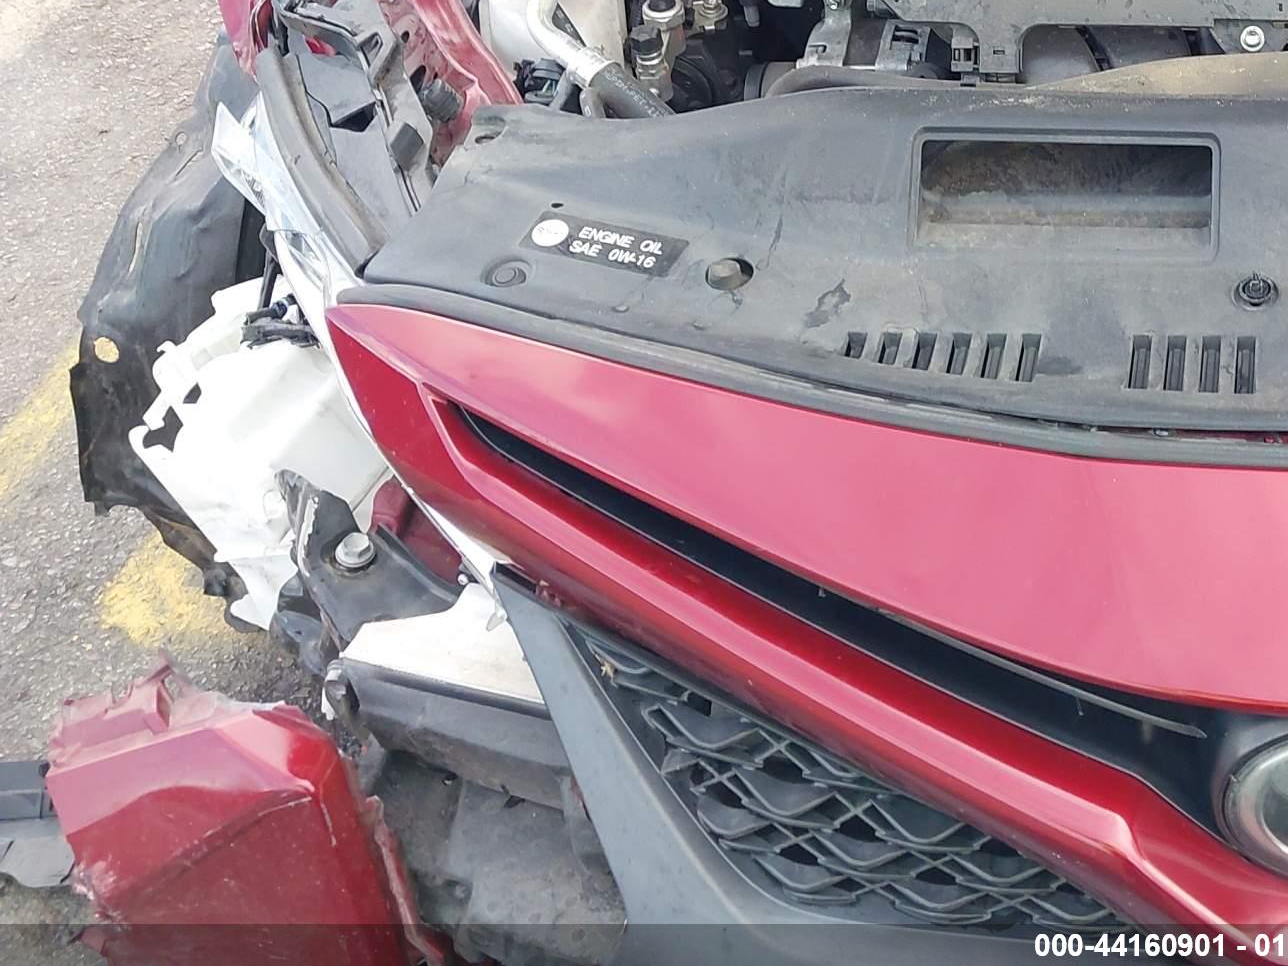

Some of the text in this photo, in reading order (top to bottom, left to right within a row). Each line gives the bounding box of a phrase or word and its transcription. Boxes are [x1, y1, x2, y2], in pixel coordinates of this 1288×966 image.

[569, 240, 657, 269] SAE 0W-16
[578, 226, 635, 248] ENGINE
[639, 239, 663, 255] OIL
